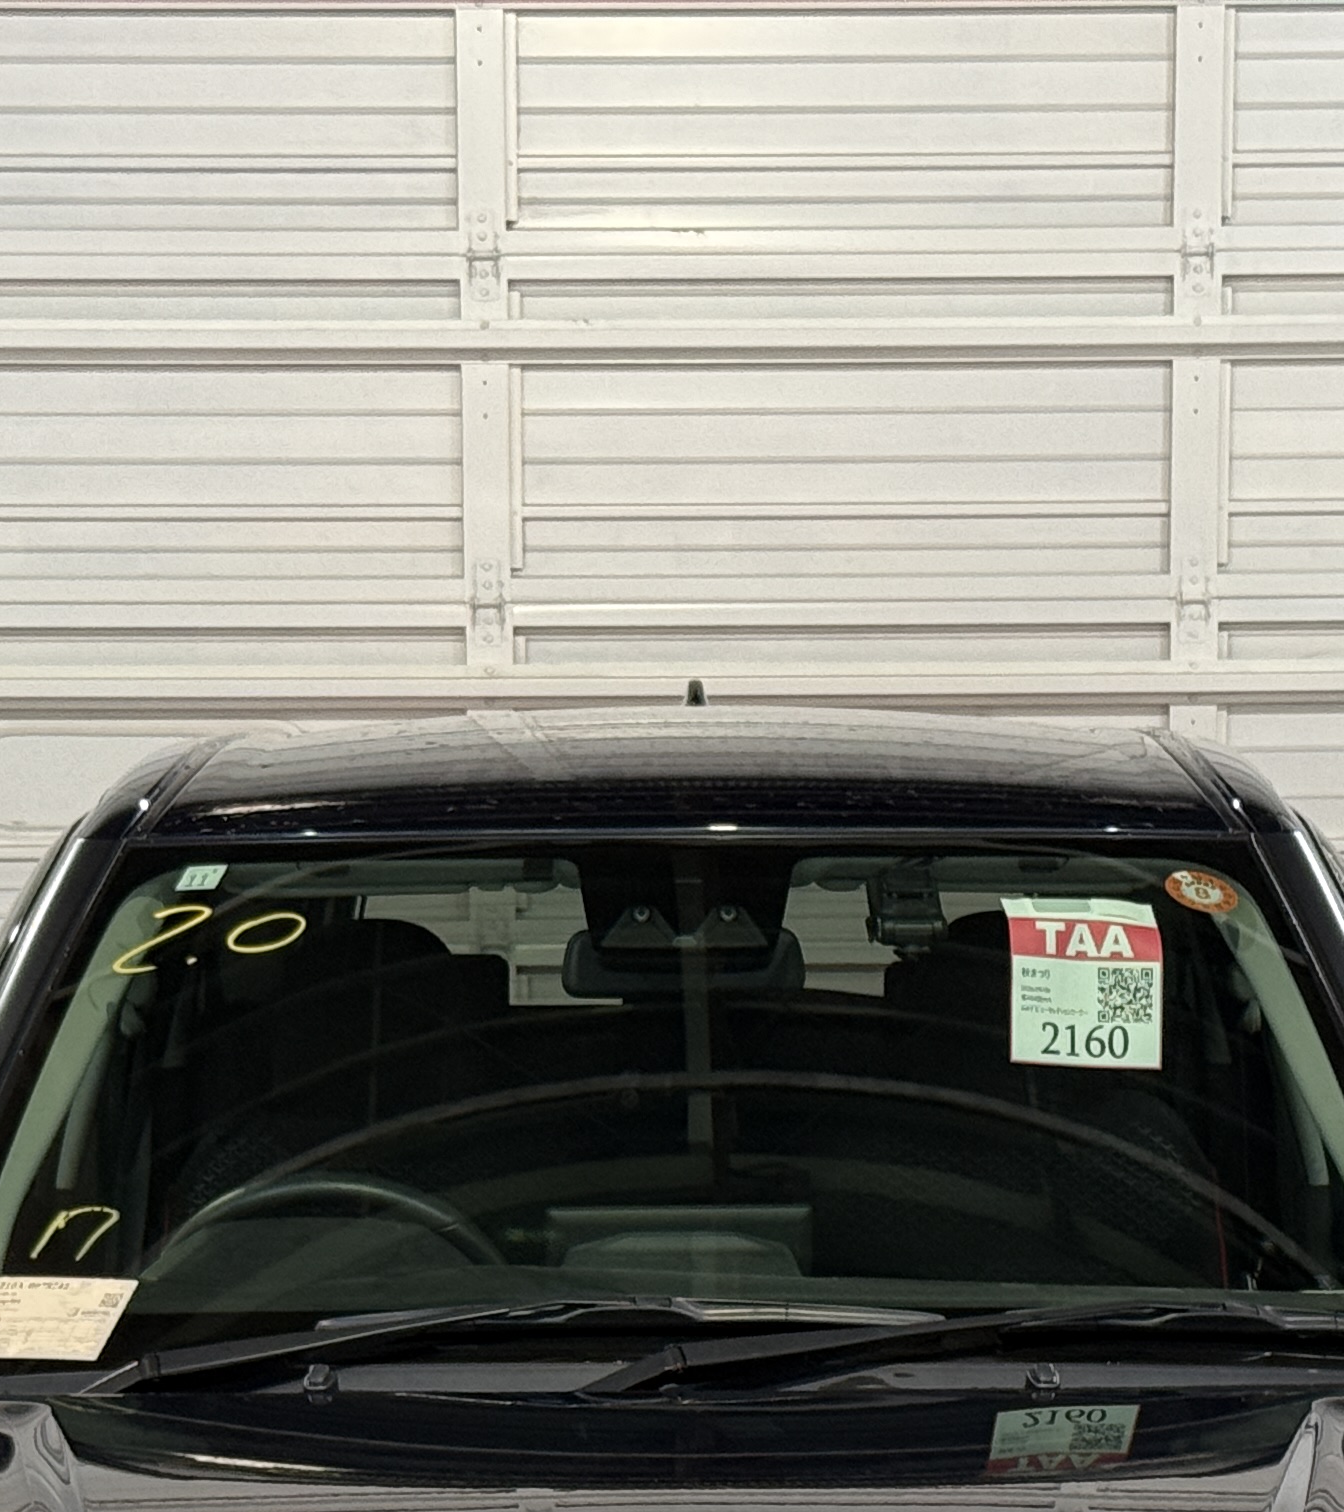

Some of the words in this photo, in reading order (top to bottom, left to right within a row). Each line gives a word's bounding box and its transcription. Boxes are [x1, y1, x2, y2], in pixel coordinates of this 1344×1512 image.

[112, 903, 306, 975] 2.0
[1035, 921, 1134, 958] TAA
[1041, 1022, 1129, 1059] 2160
